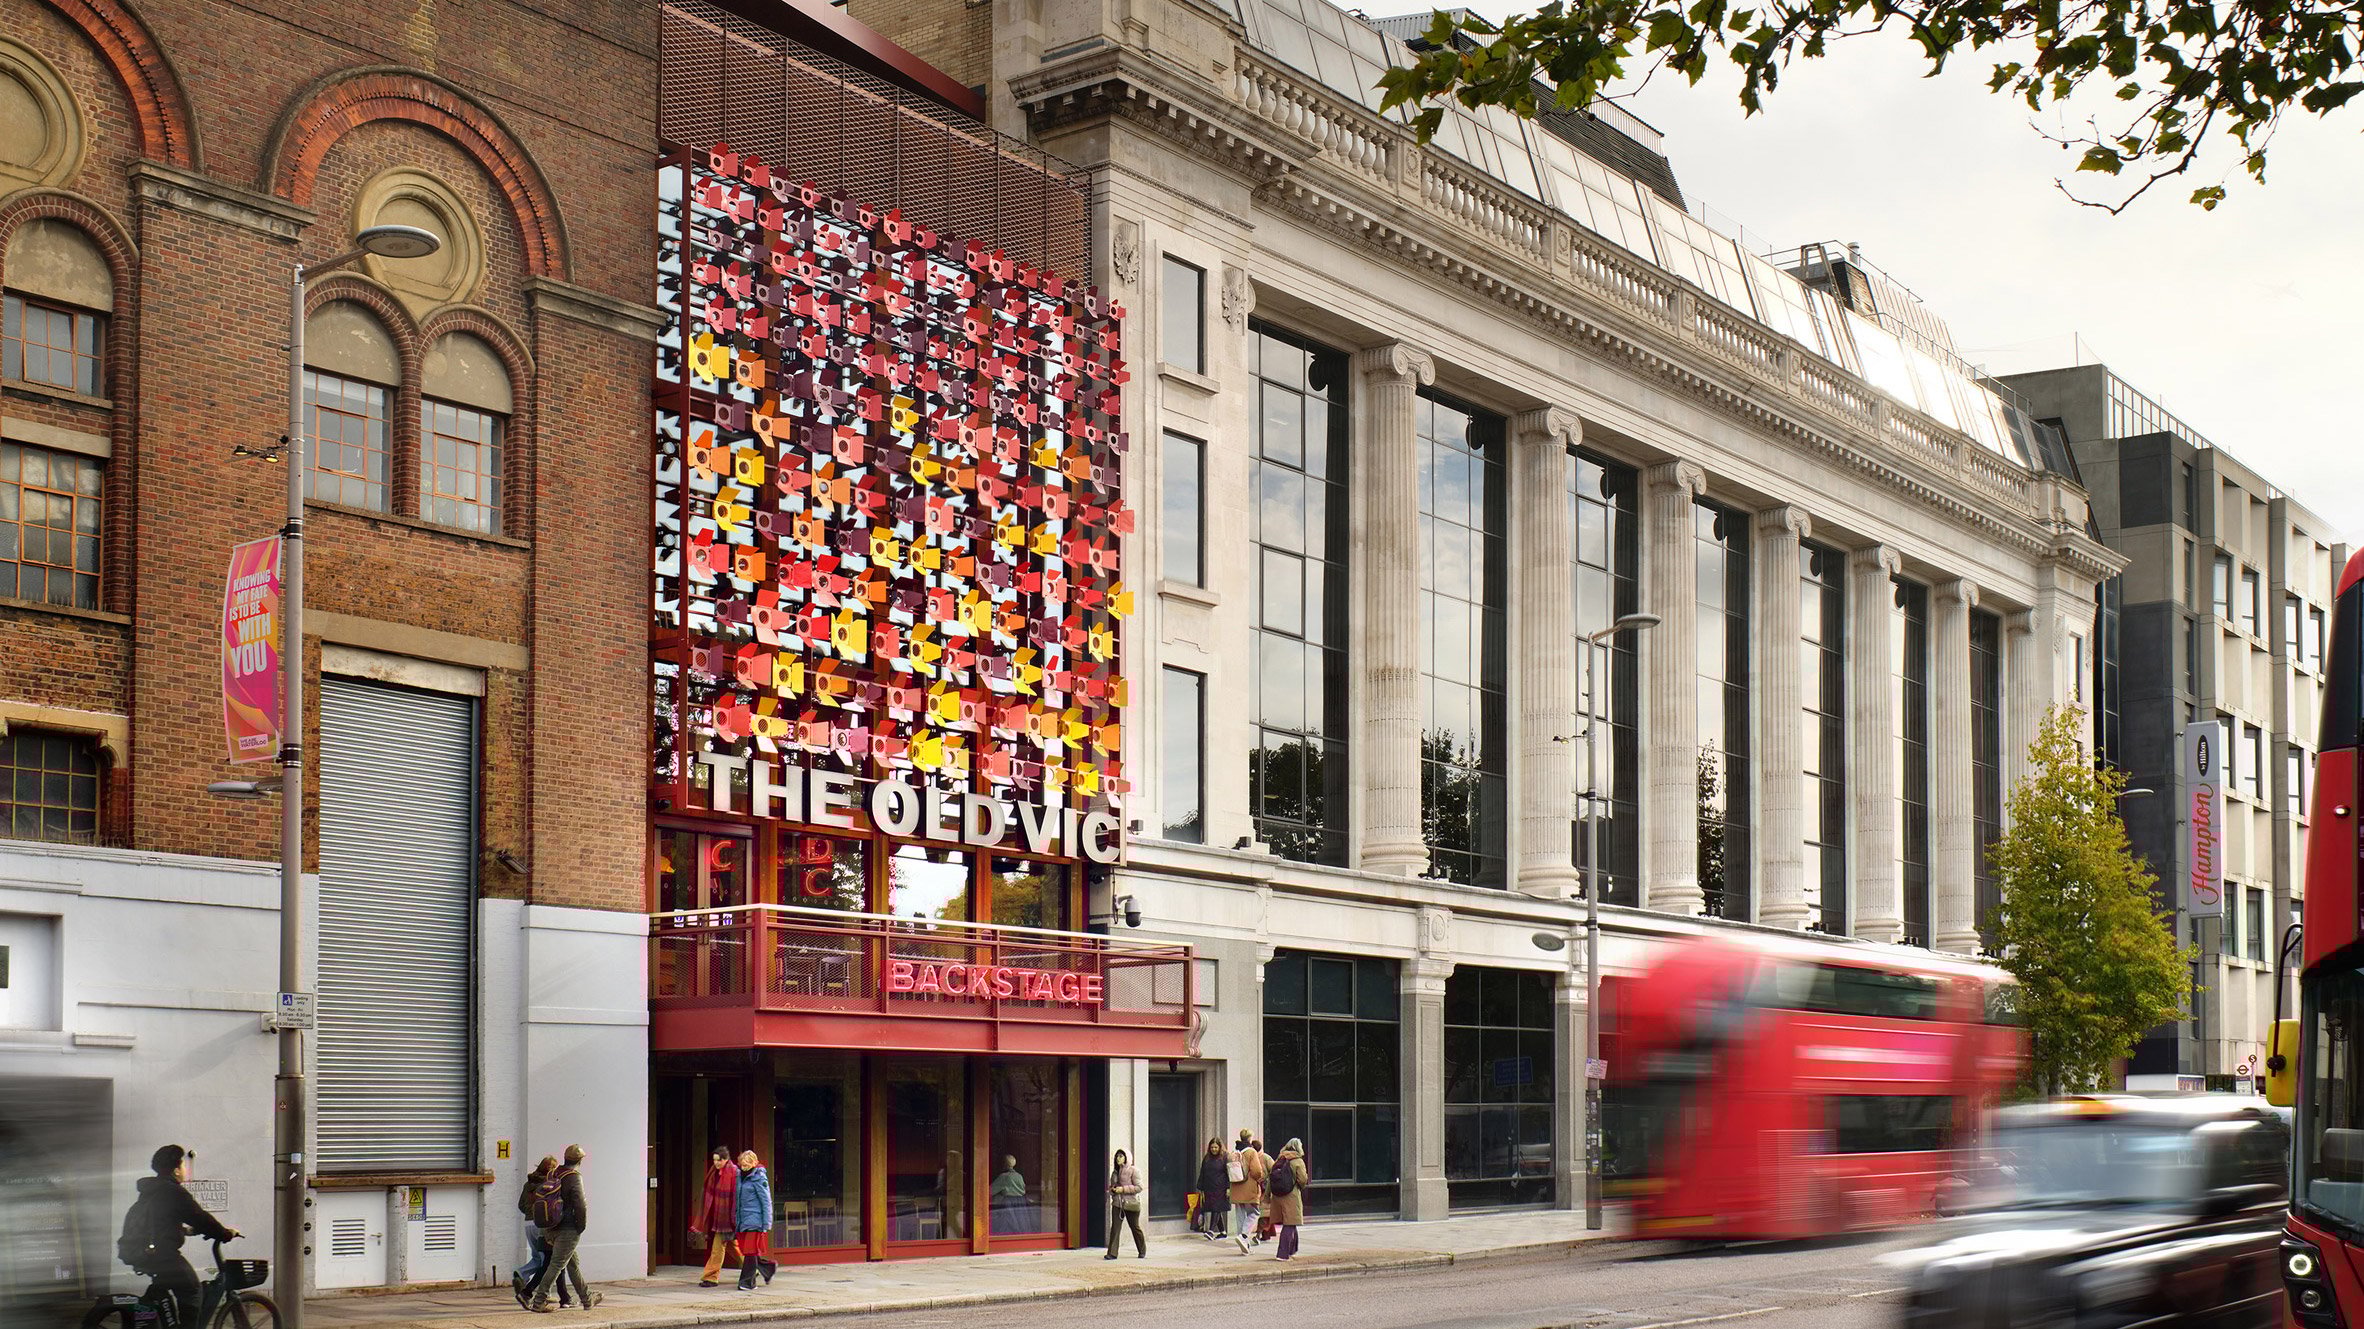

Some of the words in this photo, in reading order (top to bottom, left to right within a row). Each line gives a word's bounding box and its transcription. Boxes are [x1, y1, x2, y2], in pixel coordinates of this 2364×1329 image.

[233, 569, 271, 592] KNOWING
[237, 589, 250, 605] MY
[250, 584, 268, 601] FATE
[229, 606, 238, 622] IS
[239, 604, 249, 618] TO
[250, 600, 260, 616] BE
[238, 612, 271, 643] WITH
[230, 638, 267, 678] YOU
[698, 751, 854, 830] THE
[871, 779, 1006, 847] OLD
[1017, 799, 1121, 864] VIC
[2191, 783, 2220, 906] Hampton
[888, 961, 1104, 1001] BACKSTAGE
[497, 1141, 510, 1158] H
[182, 1182, 226, 1191] PRINKLER
[200, 1192, 226, 1201] VALVE
